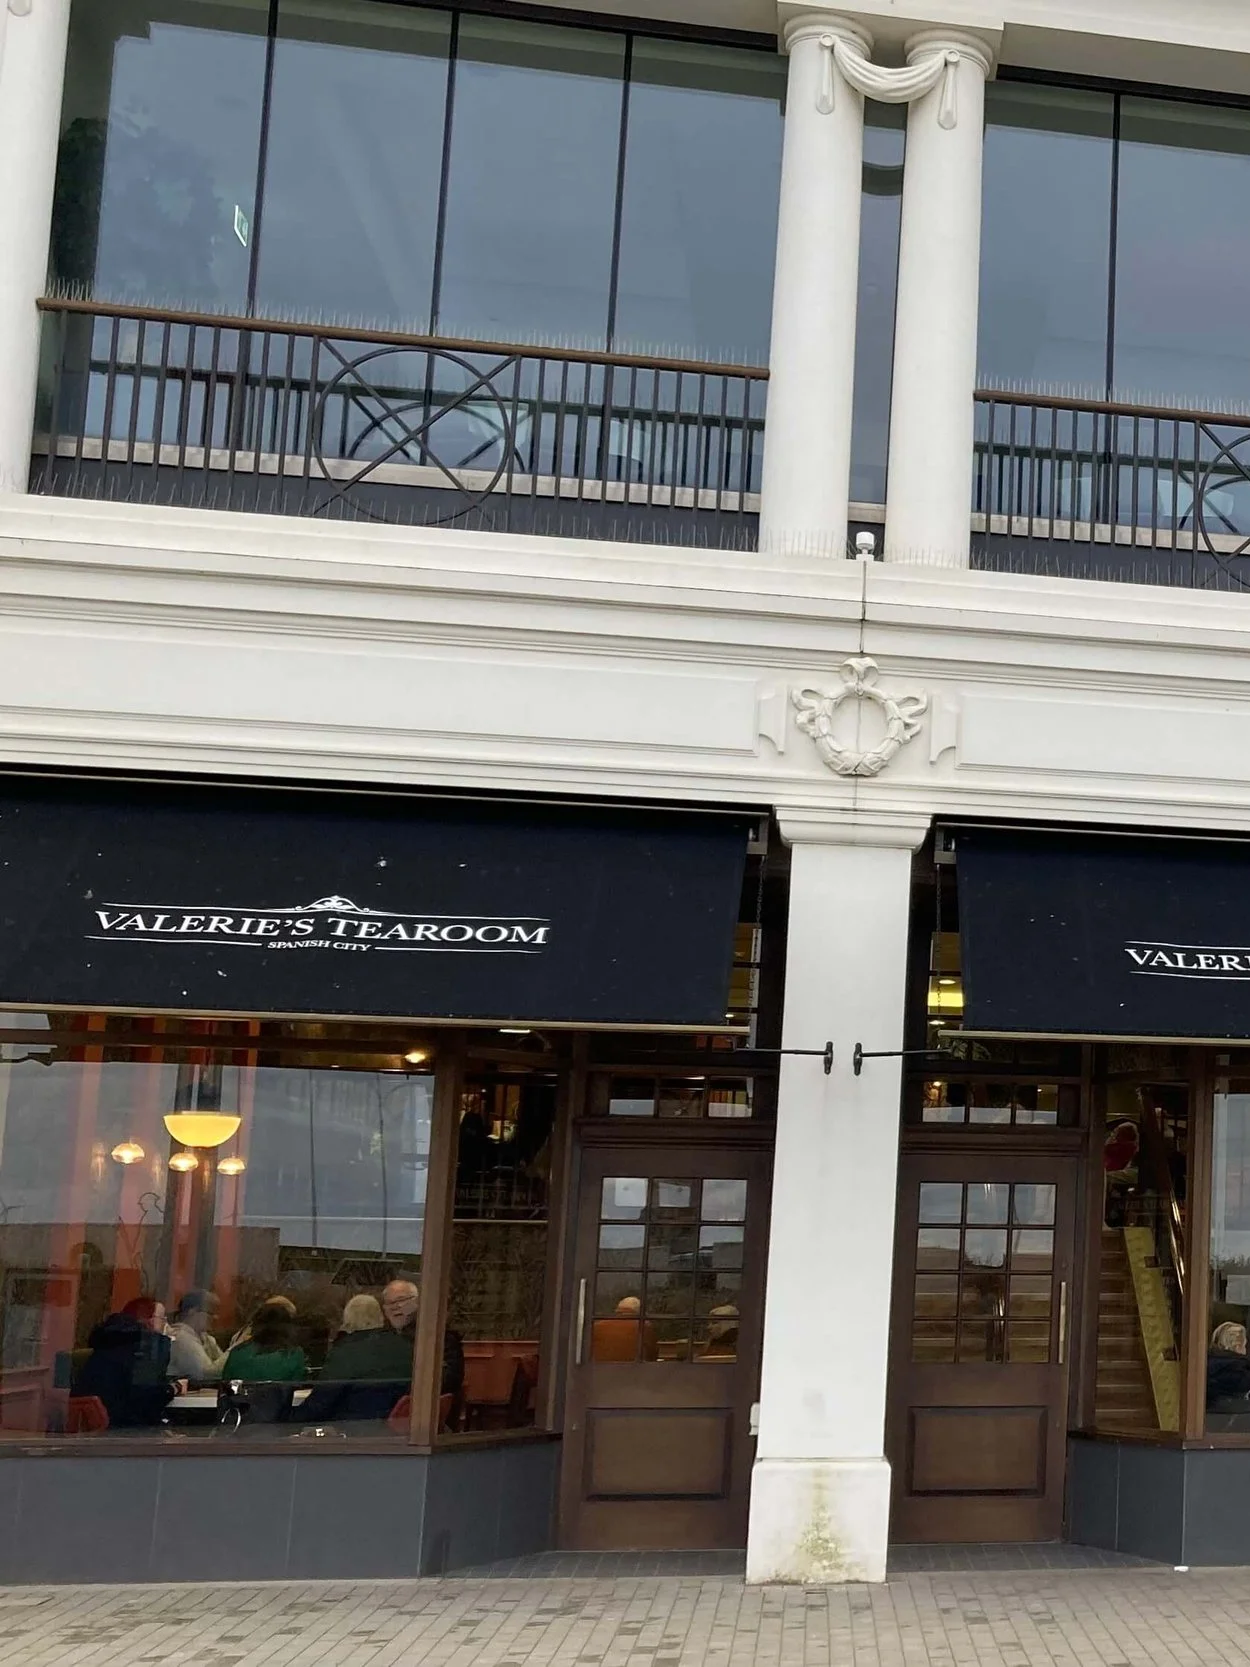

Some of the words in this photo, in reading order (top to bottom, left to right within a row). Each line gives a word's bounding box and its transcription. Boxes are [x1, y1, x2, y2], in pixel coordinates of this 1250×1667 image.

[95, 911, 314, 936] VALERIE'S
[327, 917, 550, 944] TEAROOM
[267, 939, 330, 950] SPANISH
[333, 942, 371, 952] CITY
